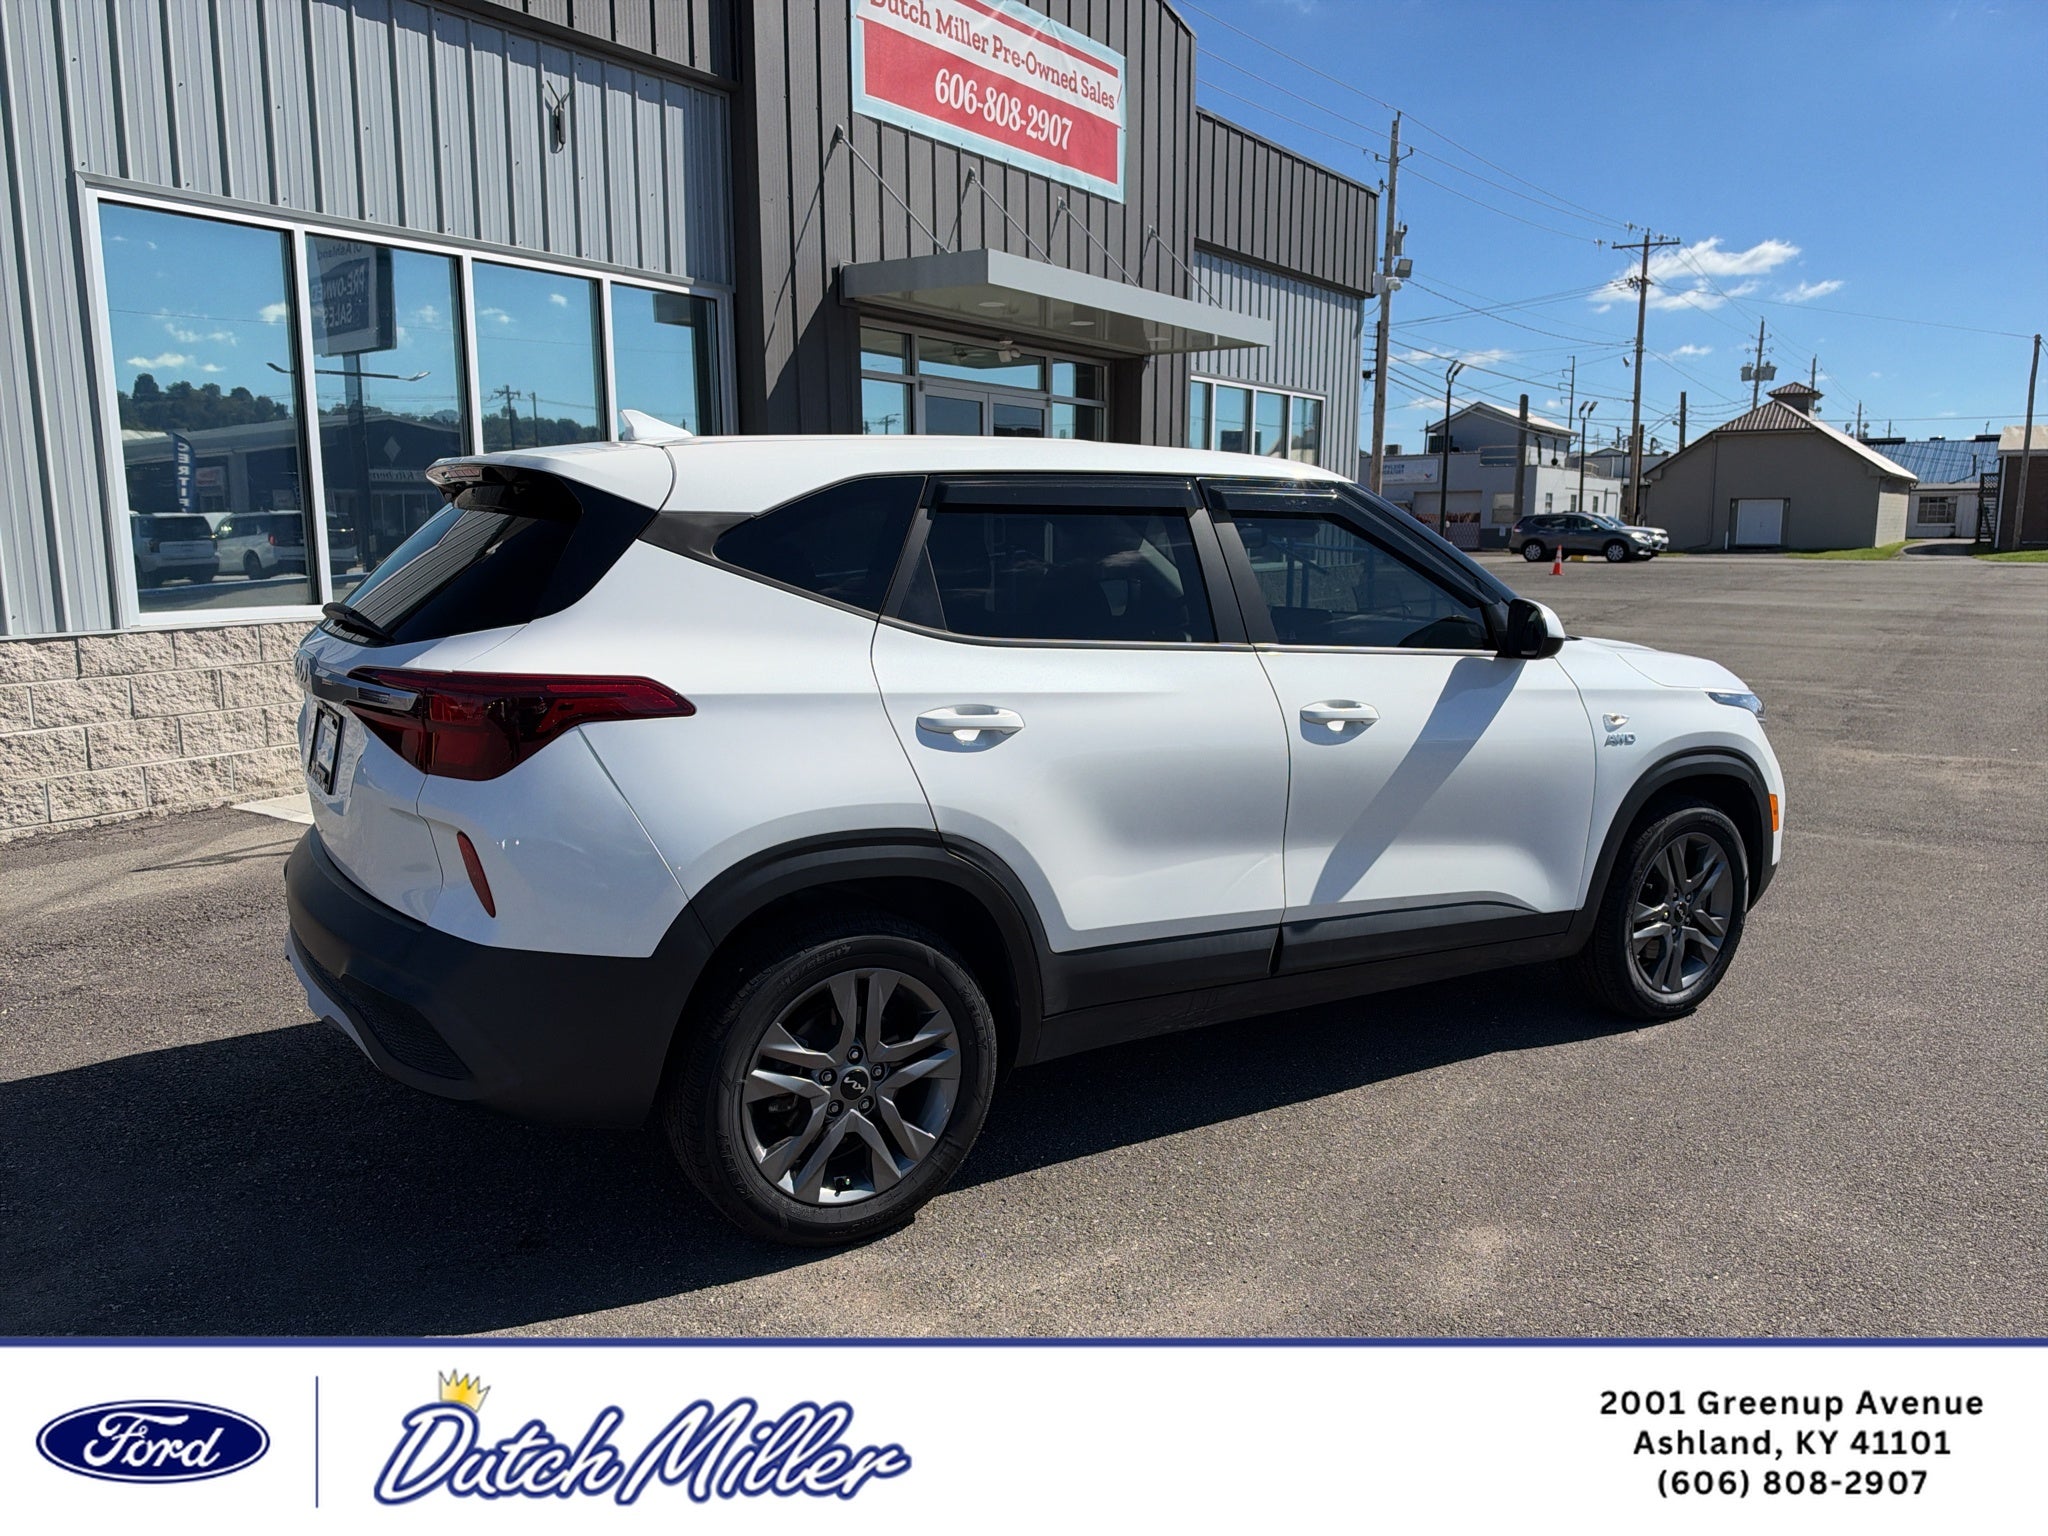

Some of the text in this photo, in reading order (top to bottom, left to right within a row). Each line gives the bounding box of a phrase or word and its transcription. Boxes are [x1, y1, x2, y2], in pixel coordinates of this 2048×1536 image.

[935, 9, 989, 54] Miller
[992, 34, 1078, 94] Pre-Owned
[1080, 76, 1115, 110] Sales
[934, 67, 1073, 150] 606-808-2907
[1604, 733, 1636, 747] AWD
